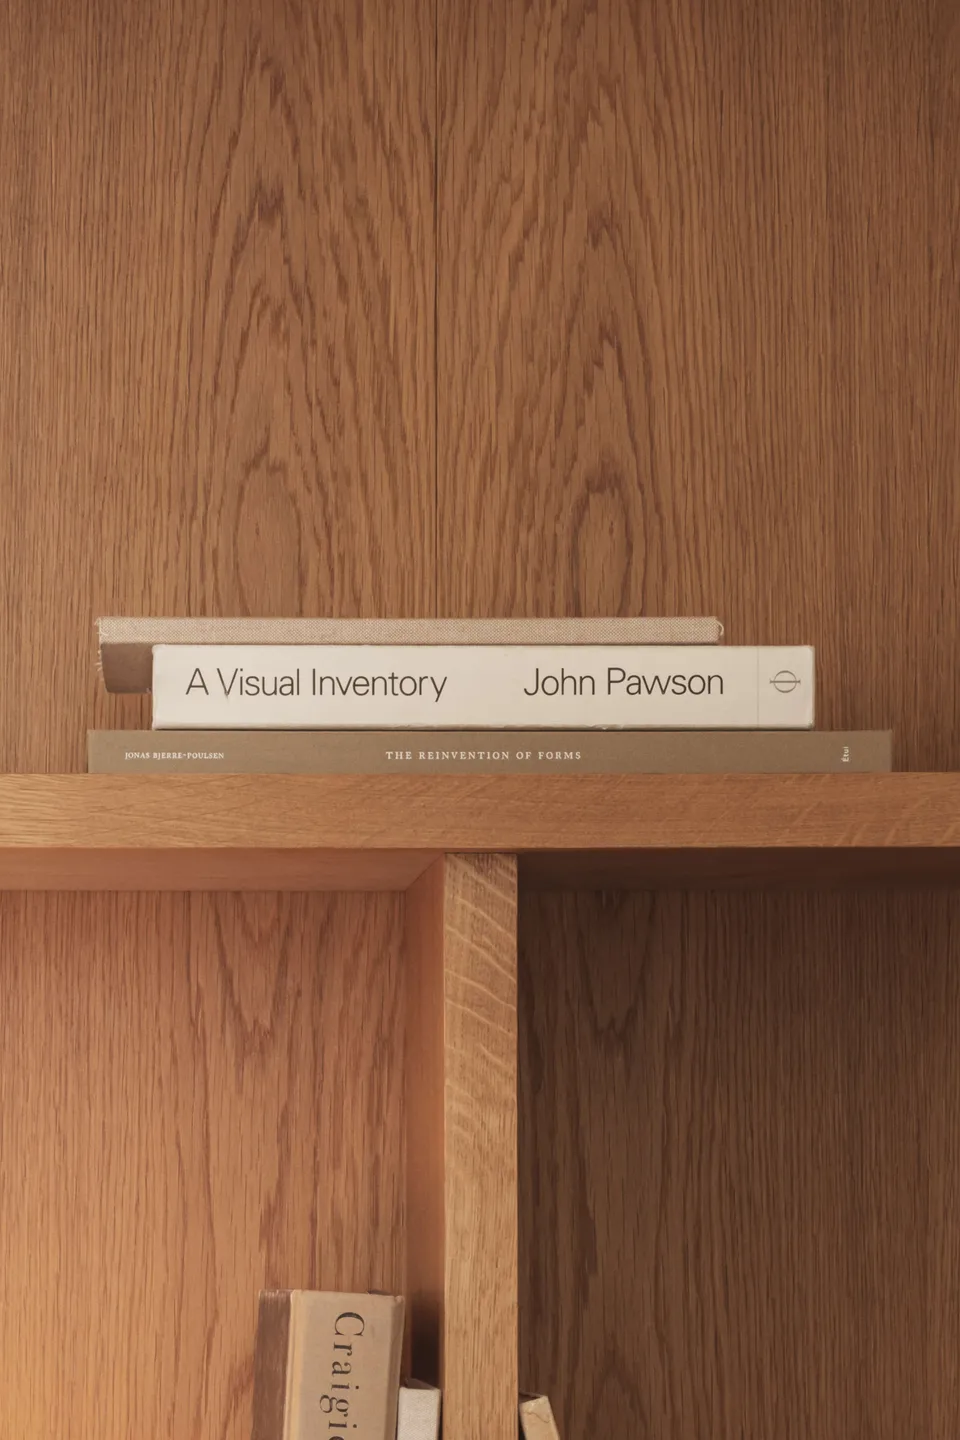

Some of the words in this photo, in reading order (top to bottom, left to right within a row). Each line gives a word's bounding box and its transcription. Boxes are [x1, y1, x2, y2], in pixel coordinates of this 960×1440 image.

[185, 667, 209, 695] A
[216, 667, 300, 696] Visual
[312, 668, 448, 703] Inventory
[523, 667, 596, 696] John
[607, 667, 724, 696] Pawson
[125, 751, 150, 760] JONAS
[152, 751, 225, 760] BJERRE-POULSEN
[385, 751, 413, 760] THE
[418, 751, 510, 760] REINVENTION
[515, 751, 533, 760] OF
[538, 751, 582, 760] FORMS
